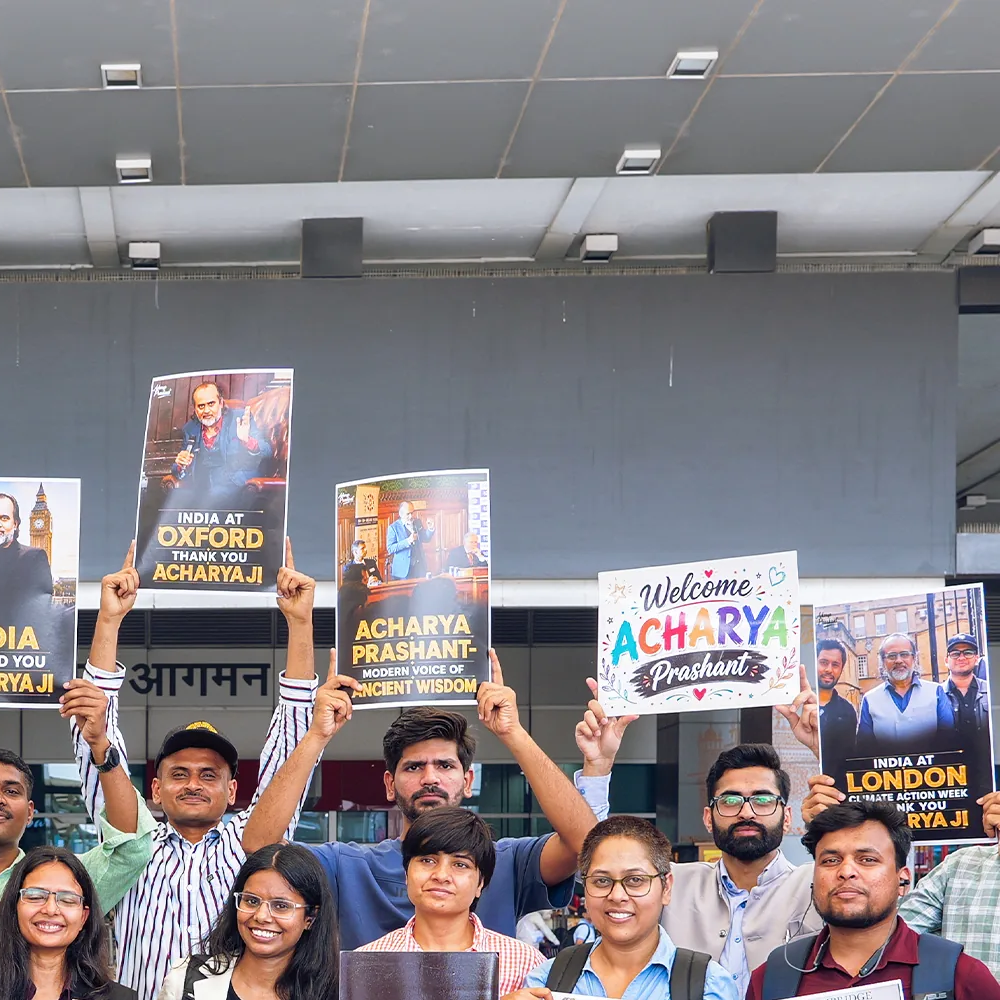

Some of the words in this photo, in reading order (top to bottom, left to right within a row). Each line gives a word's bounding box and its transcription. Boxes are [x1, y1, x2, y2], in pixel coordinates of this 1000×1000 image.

[177, 511, 220, 524] INDIA
[224, 512, 244, 525] AT
[157, 525, 264, 549] OXFORD
[171, 550, 217, 562] THANK
[220, 551, 248, 563] YOU
[152, 563, 245, 583] ACHARYA
[245, 565, 263, 584] JI
[639, 572, 753, 612] Welcome
[354, 614, 471, 640] ACHARYA
[610, 604, 789, 667] ACHARYA
[12, 655, 46, 668] YOU
[352, 639, 478, 665] PRASHANT-
[128, 663, 271, 697] आगमन
[362, 666, 409, 679] MODERN
[412, 664, 447, 676] VOICE
[449, 664, 465, 674] OF
[650, 650, 752, 691] Prashant
[36, 673, 54, 693] JI
[415, 678, 477, 694] WISDOM
[873, 757, 913, 769] INDIA
[917, 755, 935, 766] AT
[845, 764, 967, 792] LONDON
[896, 790, 936, 802] ACTION
[937, 788, 968, 799] WEEK
[919, 800, 947, 811] YOU
[950, 810, 969, 827] JI
